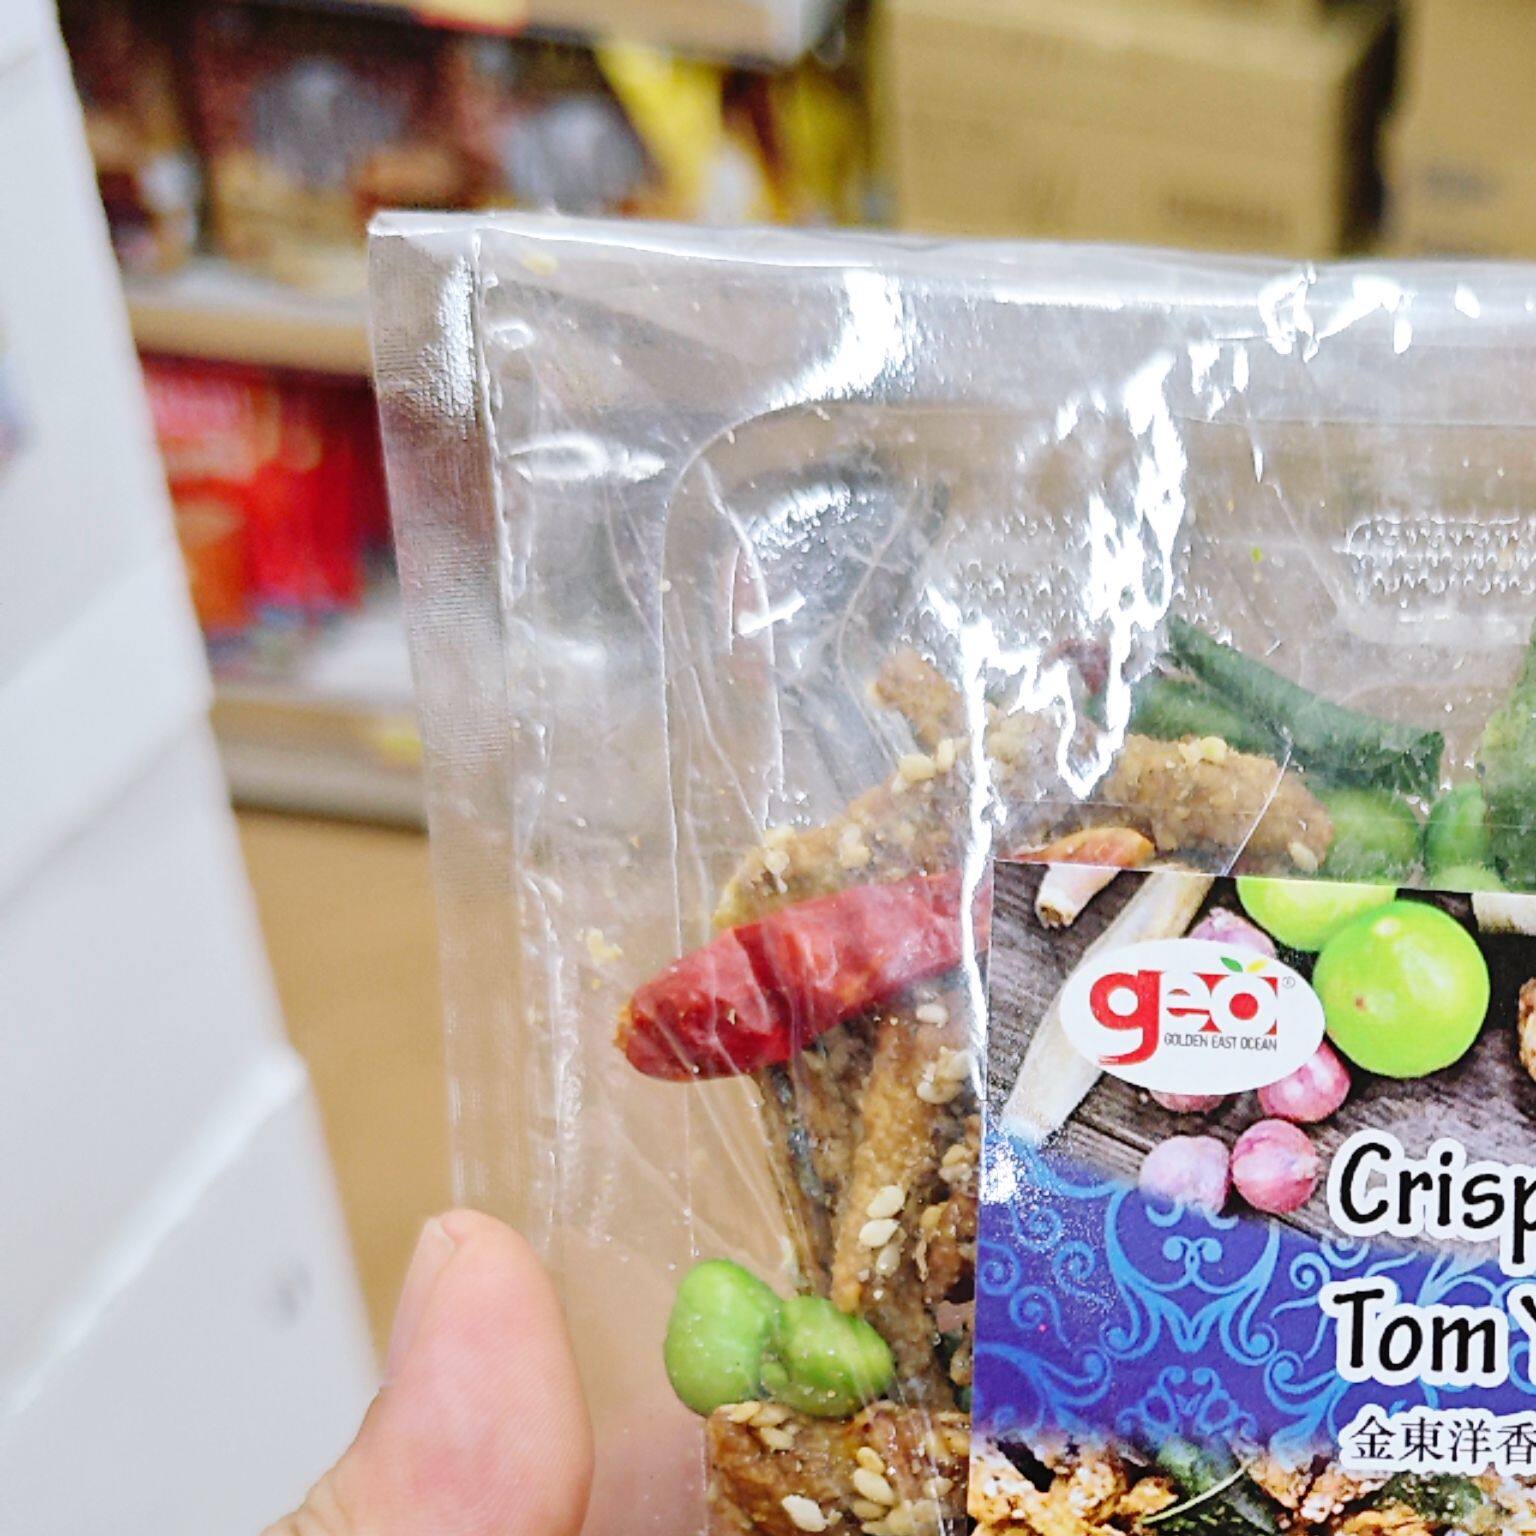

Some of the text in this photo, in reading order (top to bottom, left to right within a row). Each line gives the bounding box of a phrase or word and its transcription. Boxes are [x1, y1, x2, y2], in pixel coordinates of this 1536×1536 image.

[1164, 1033, 1277, 1050] GOLDEN EAST OCEAN
[1334, 1288, 1497, 1376] Tom
